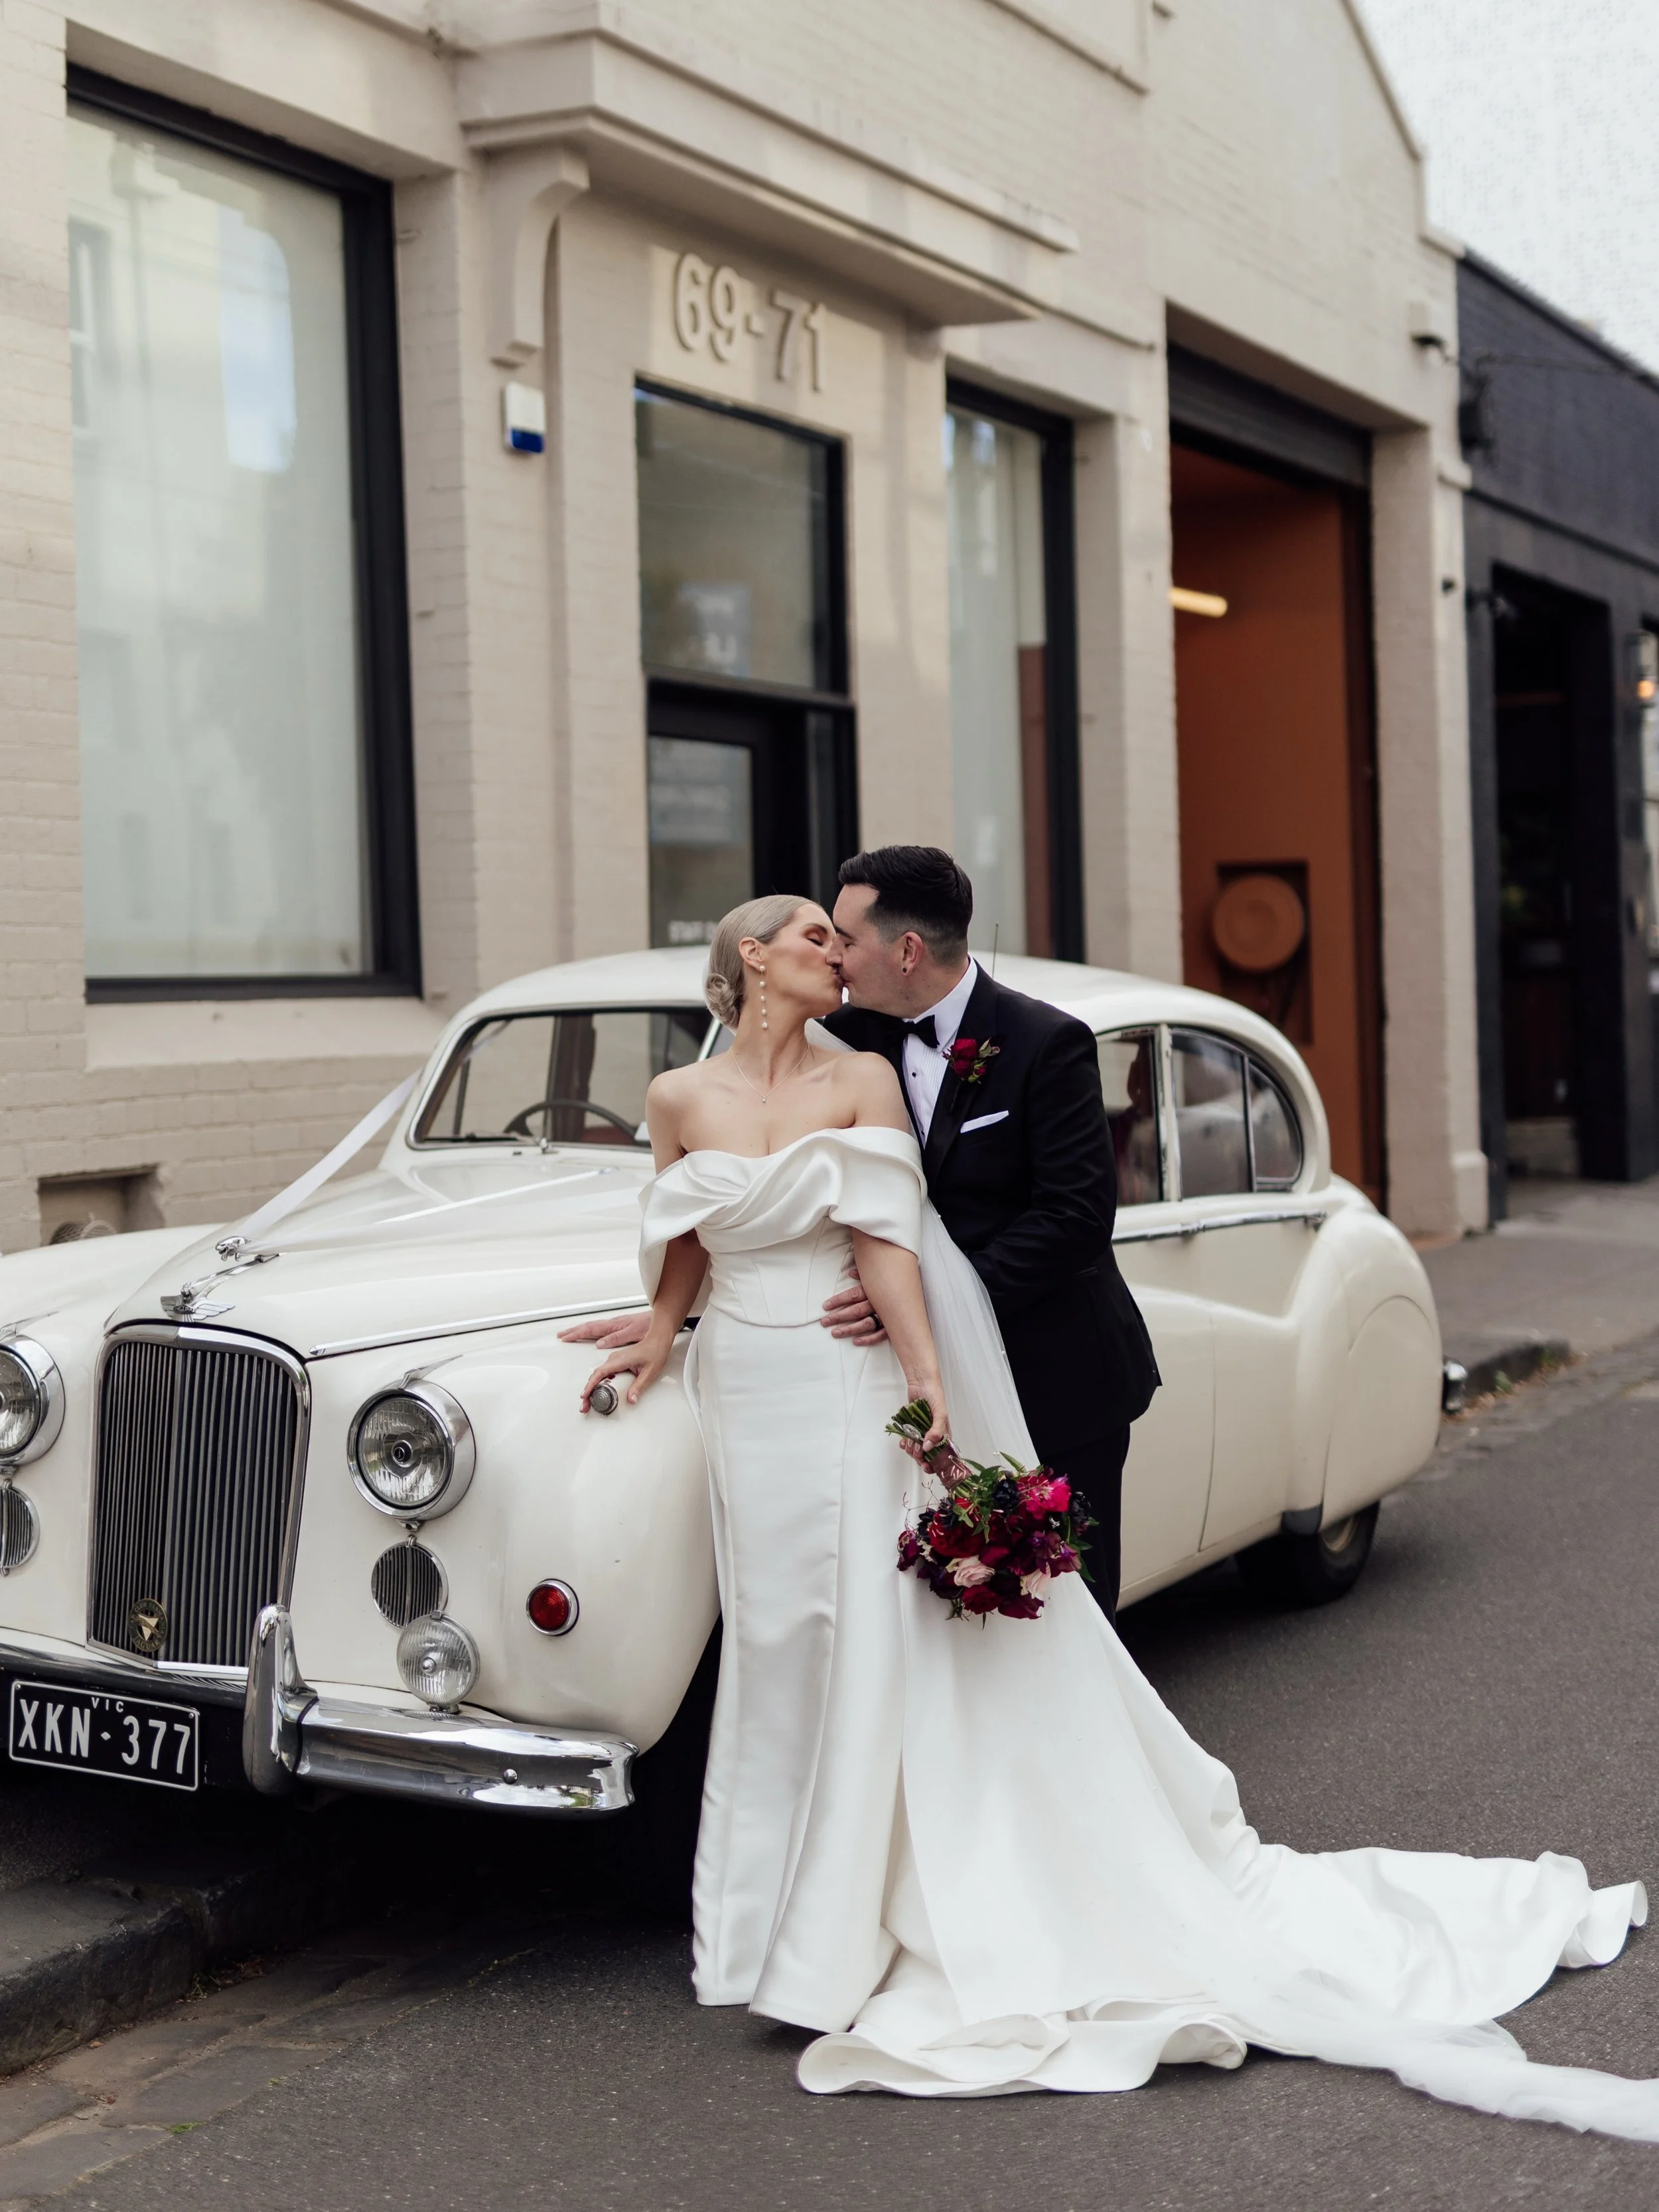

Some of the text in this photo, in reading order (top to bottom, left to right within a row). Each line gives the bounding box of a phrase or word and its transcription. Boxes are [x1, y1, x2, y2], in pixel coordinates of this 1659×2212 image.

[672, 252, 827, 394] 69-71
[133, 1635, 160, 1650] JAGUAR
[92, 1697, 124, 1713] VIC
